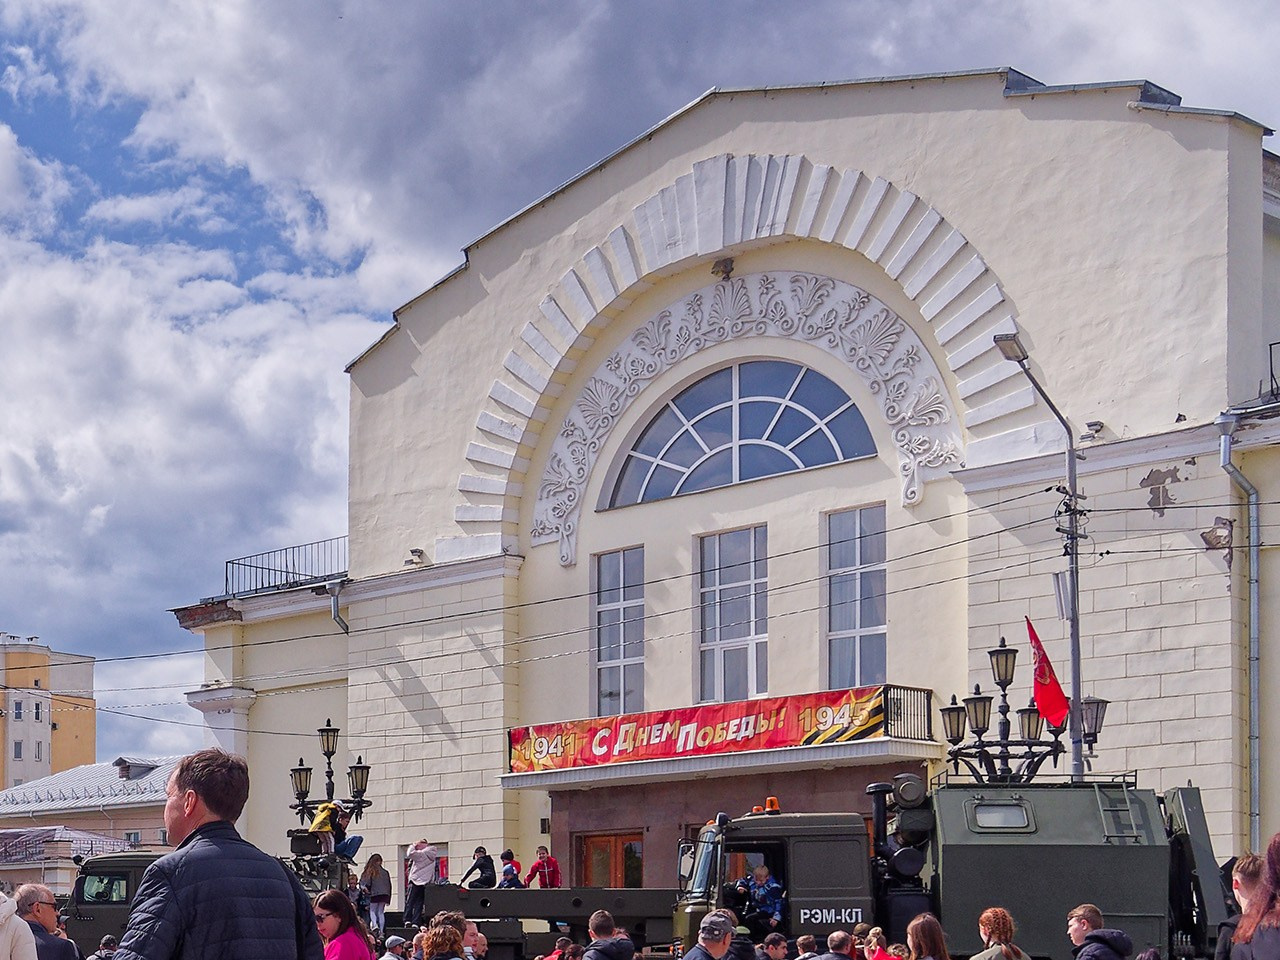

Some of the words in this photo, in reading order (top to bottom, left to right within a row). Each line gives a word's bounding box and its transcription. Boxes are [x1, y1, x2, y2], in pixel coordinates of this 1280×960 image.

[520, 733, 577, 760] 1941
[591, 727, 613, 757] С
[798, 701, 871, 733] 1945
[800, 908, 863, 924] РЭМ-КЛ
